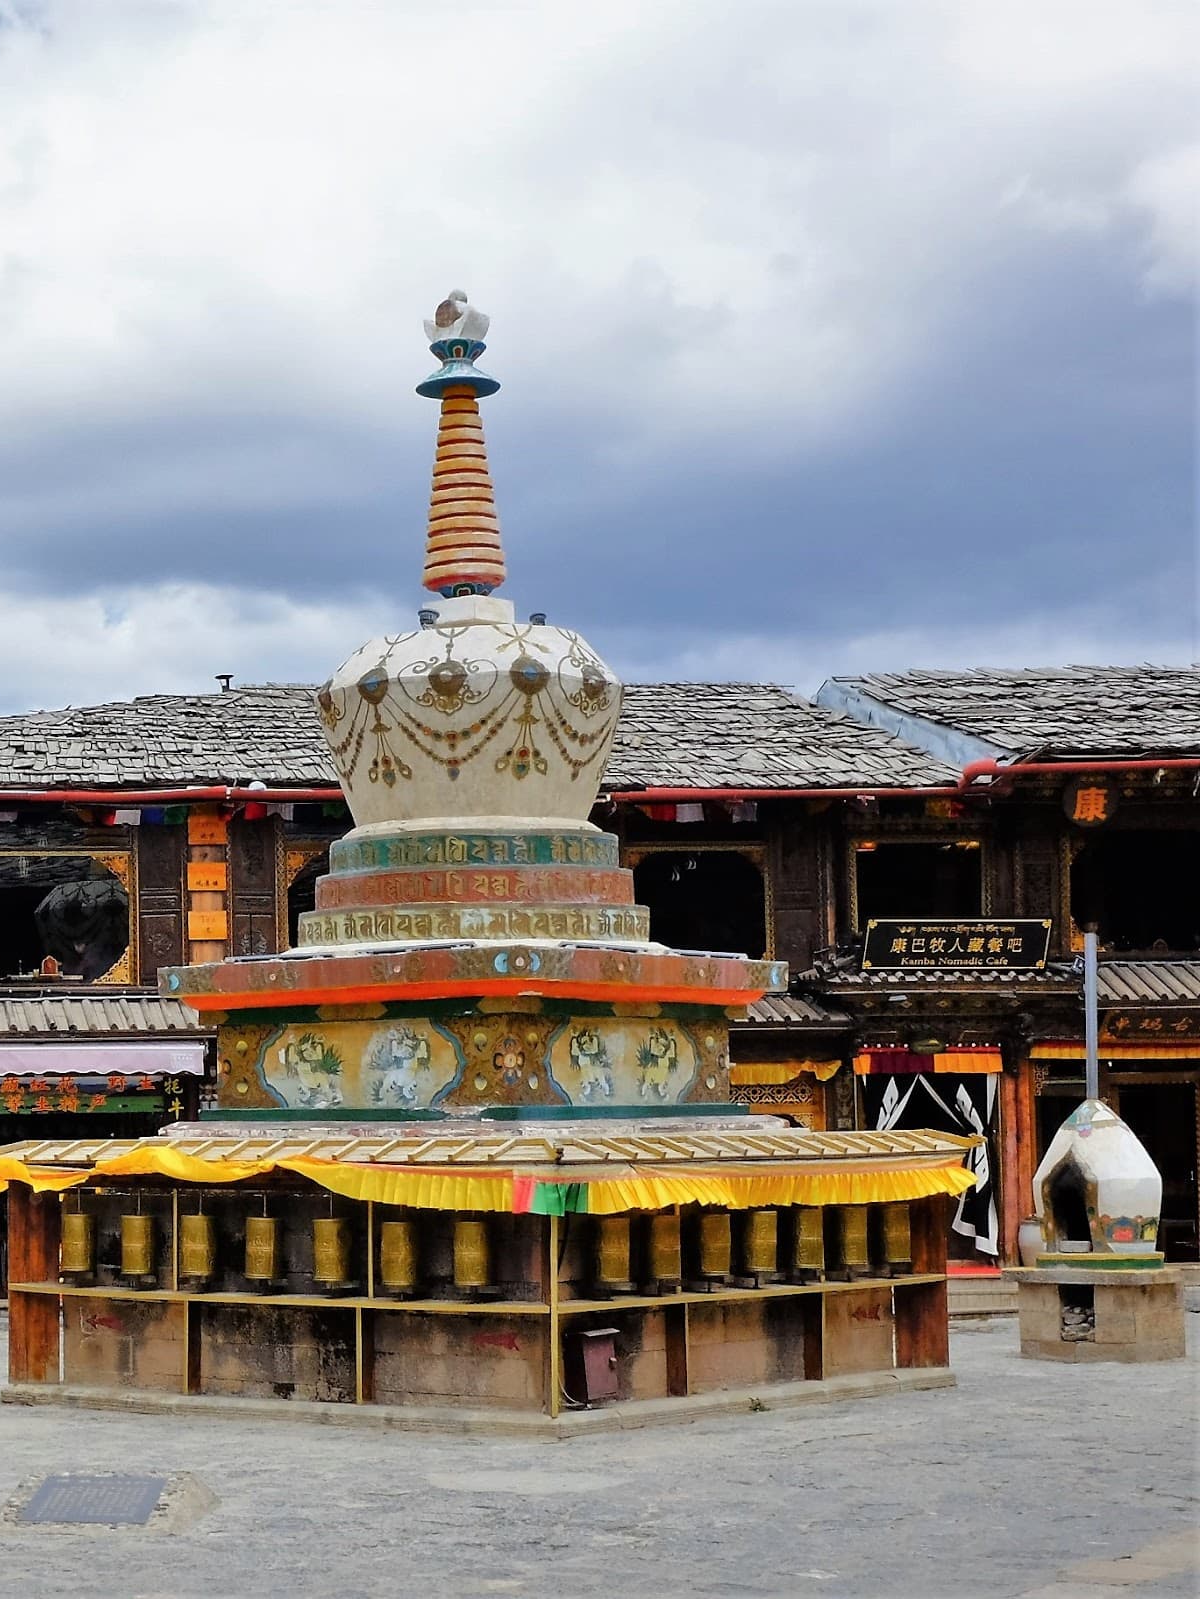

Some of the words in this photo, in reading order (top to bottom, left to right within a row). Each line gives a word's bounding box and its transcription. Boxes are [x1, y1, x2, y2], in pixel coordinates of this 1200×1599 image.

[1073, 787, 1108, 821] 康
[890, 937, 1023, 953] 康巴牧人藏餐吧
[901, 957, 935, 966] Kamba
[938, 957, 982, 966] Nomadic
[107, 1075, 156, 1093] 野生
[164, 1077, 185, 1120] 牦牛
